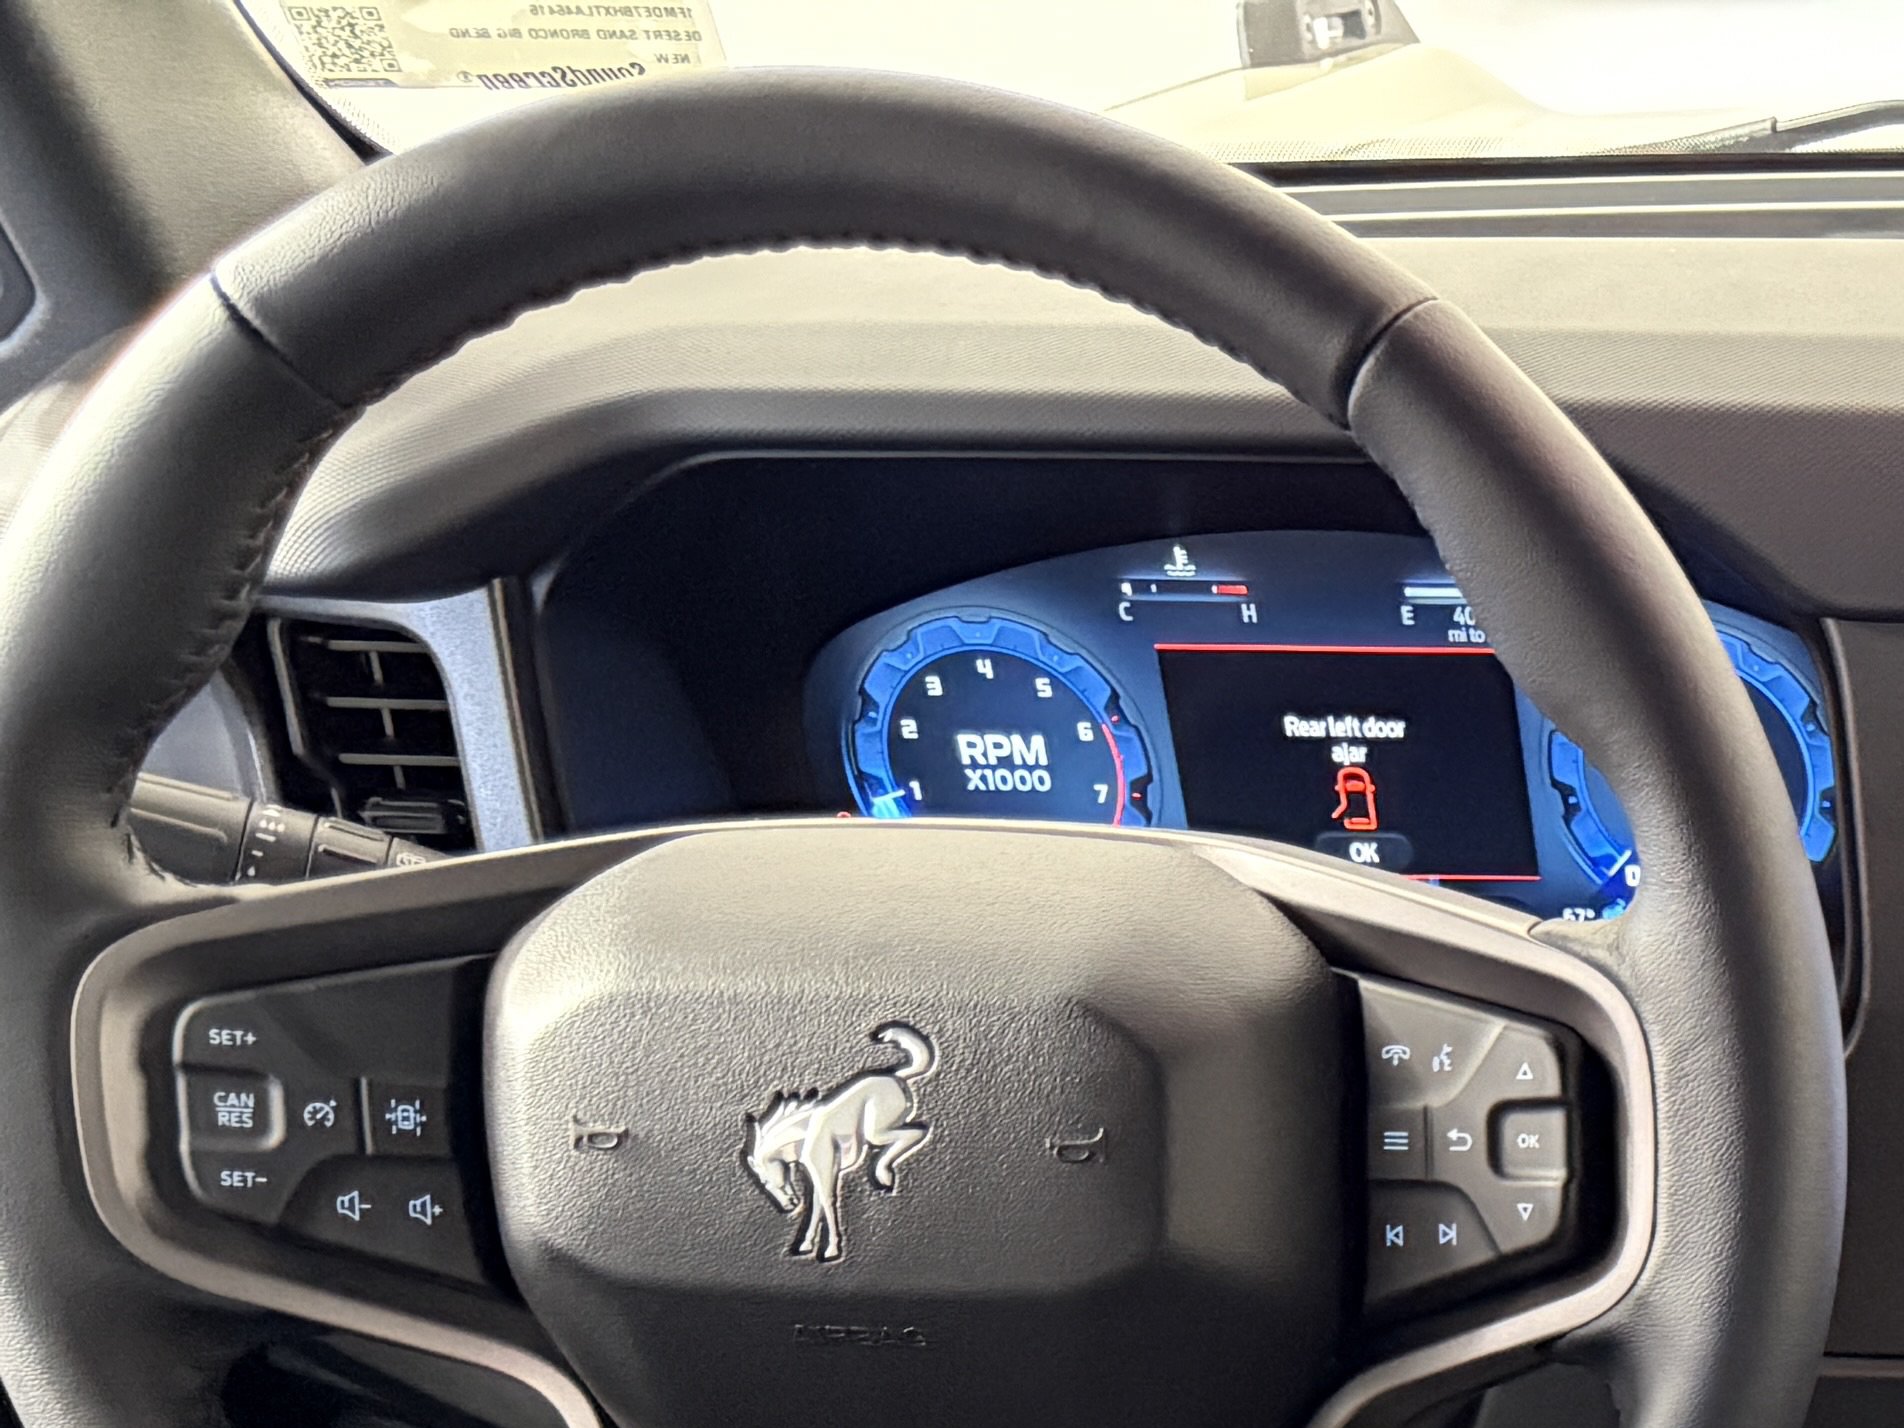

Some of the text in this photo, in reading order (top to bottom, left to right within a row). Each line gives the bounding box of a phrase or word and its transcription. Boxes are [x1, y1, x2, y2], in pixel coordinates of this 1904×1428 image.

[1119, 603, 1133, 621] C
[1241, 604, 1257, 623] H
[1400, 606, 1415, 625] E
[1448, 628, 1467, 642] mi
[976, 658, 994, 679] 4
[925, 675, 943, 696] 3
[1034, 677, 1052, 697] 5
[900, 718, 919, 739] 2
[1076, 721, 1094, 741] 6
[1284, 714, 1406, 738] Rear left door
[957, 733, 1048, 766] RPM
[1331, 742, 1368, 765] ajar
[964, 768, 1052, 792] X1000
[909, 781, 922, 800] 1
[1093, 784, 1109, 803] 7
[1349, 841, 1380, 863] OK
[208, 1028, 257, 1046] SET+
[213, 1092, 255, 1107] CAN
[217, 1112, 254, 1128] RES
[1516, 1132, 1540, 1149] OK
